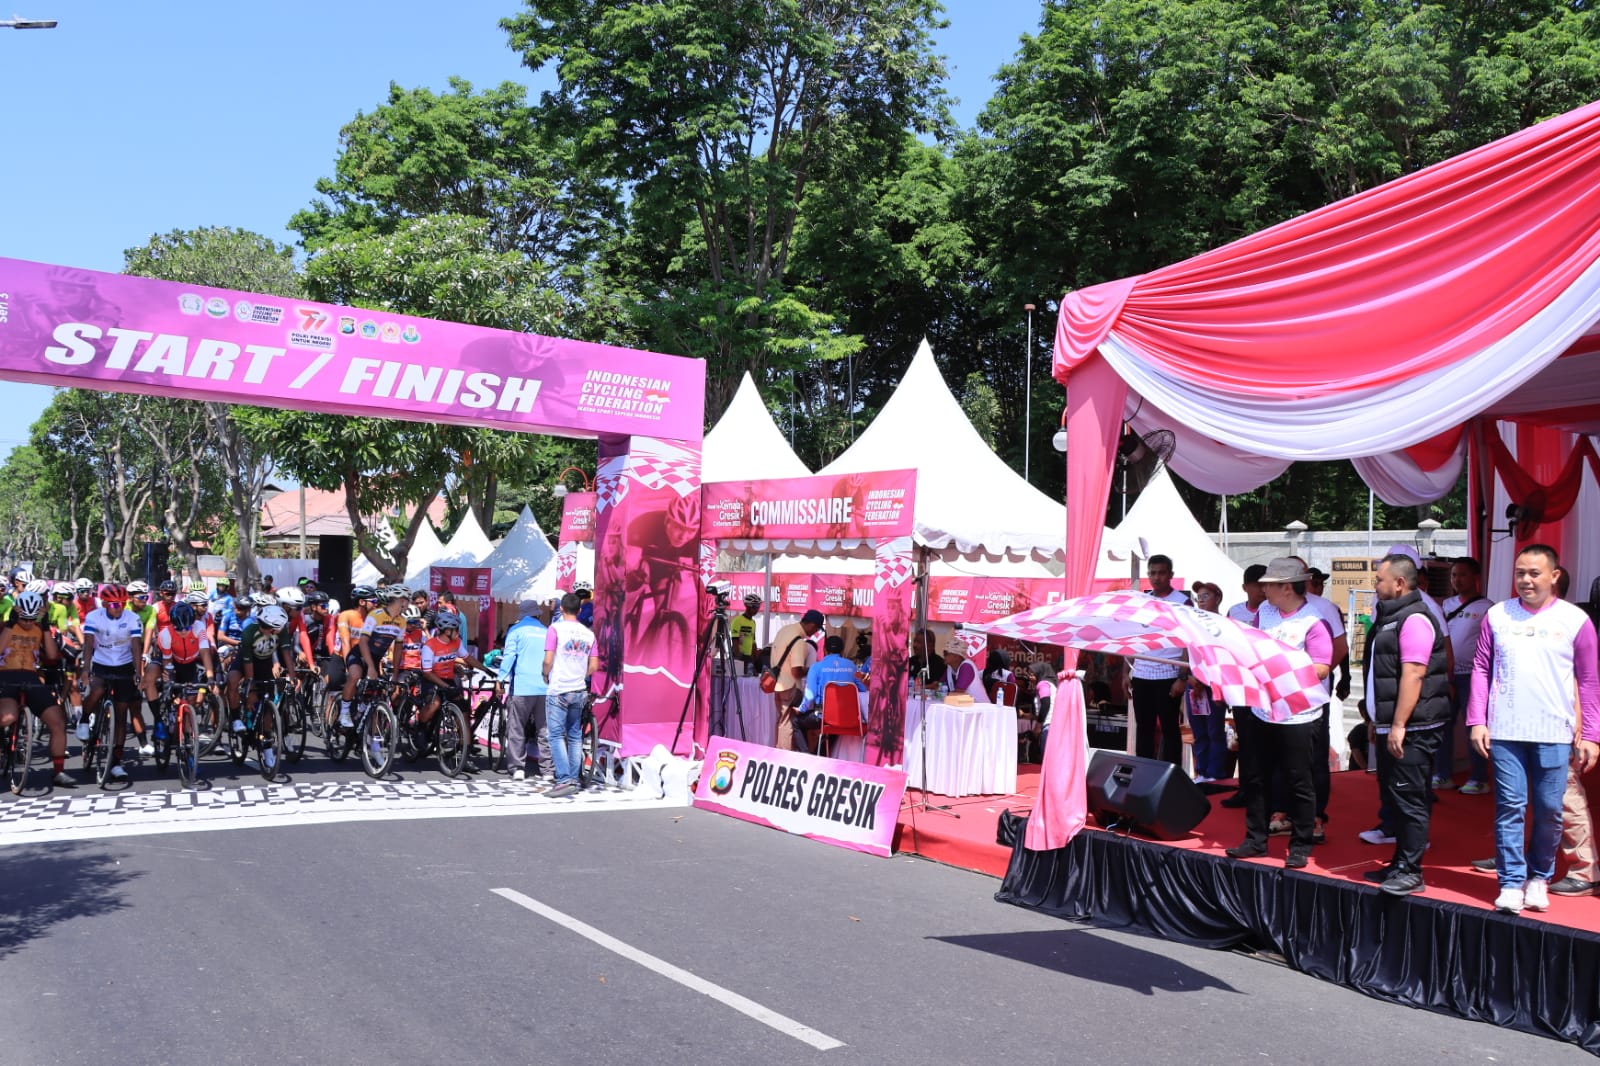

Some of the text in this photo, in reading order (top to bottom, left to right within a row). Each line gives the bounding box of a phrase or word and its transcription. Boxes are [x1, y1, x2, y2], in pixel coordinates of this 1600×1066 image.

[45, 322, 287, 384] START
[340, 357, 542, 414] FINISH
[581, 382, 643, 400] CYCLING
[586, 369, 671, 392] INDONESIAN
[579, 394, 663, 415] FEDERATION
[750, 497, 853, 526] COMMISSAIRE
[865, 499, 892, 510] CYCLING
[987, 600, 1010, 609] Gresik
[1499, 649, 1509, 695] Gresik
[740, 760, 884, 830] POLRES GRESIK
